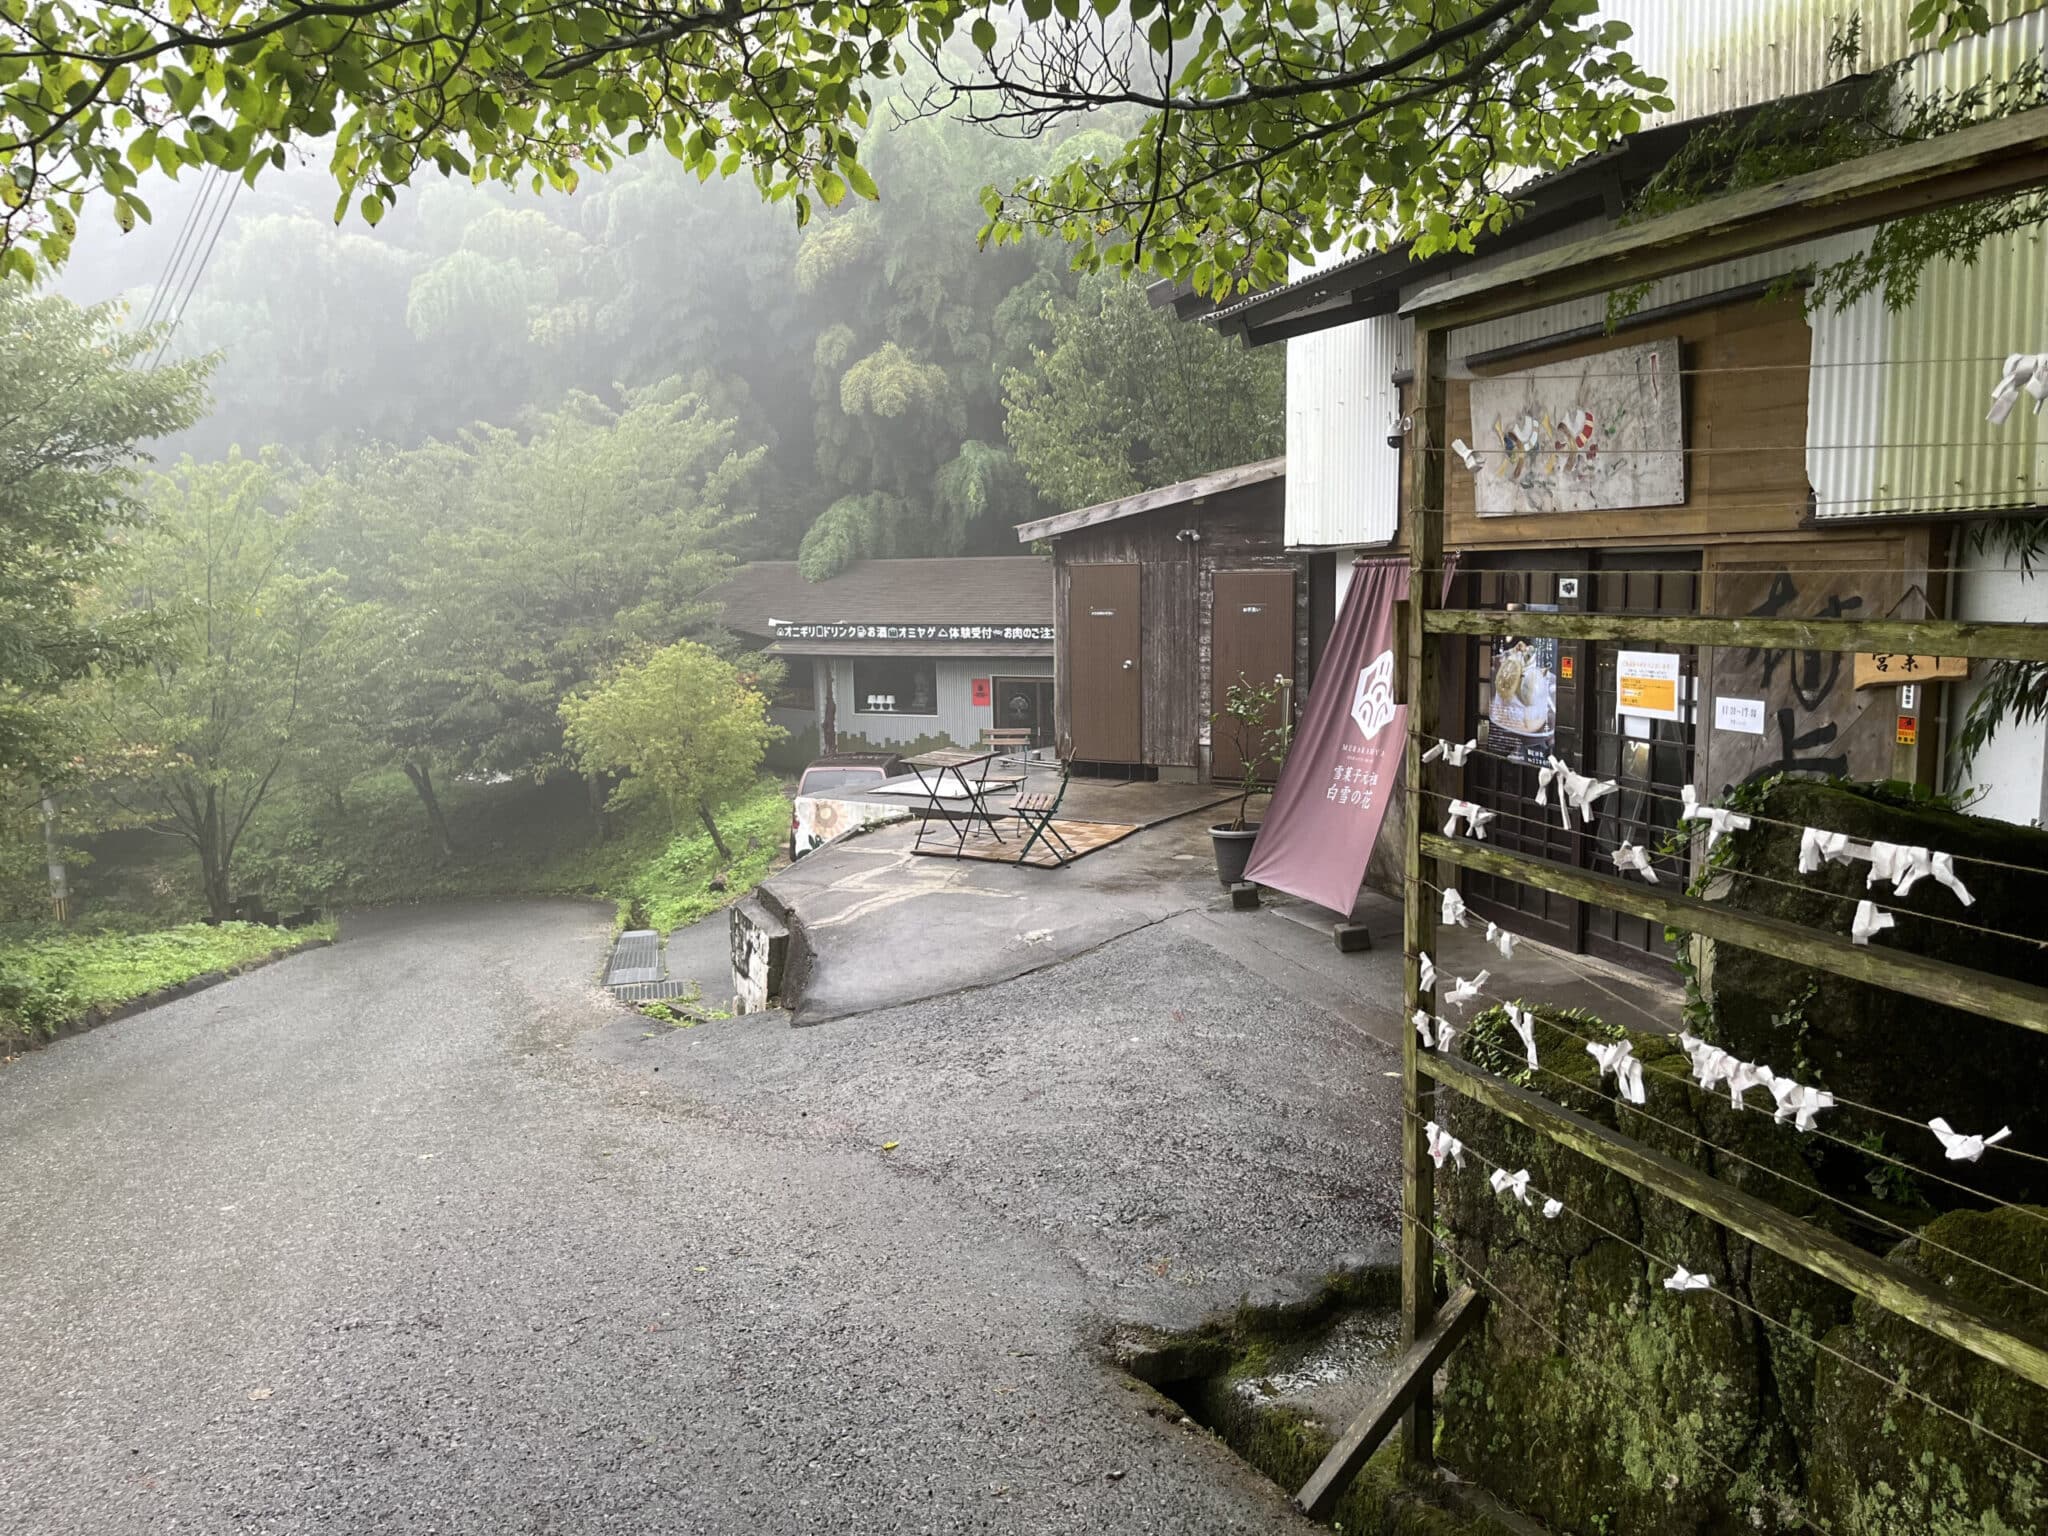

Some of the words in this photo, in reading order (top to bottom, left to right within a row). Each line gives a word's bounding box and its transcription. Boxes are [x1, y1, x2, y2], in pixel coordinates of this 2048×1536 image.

[784, 626, 816, 638] オニギリ
[824, 626, 856, 638] ドリンク
[867, 626, 887, 638] お酒
[898, 626, 936, 638] オミヤゲ
[1327, 783, 1373, 809] 白雪の花
